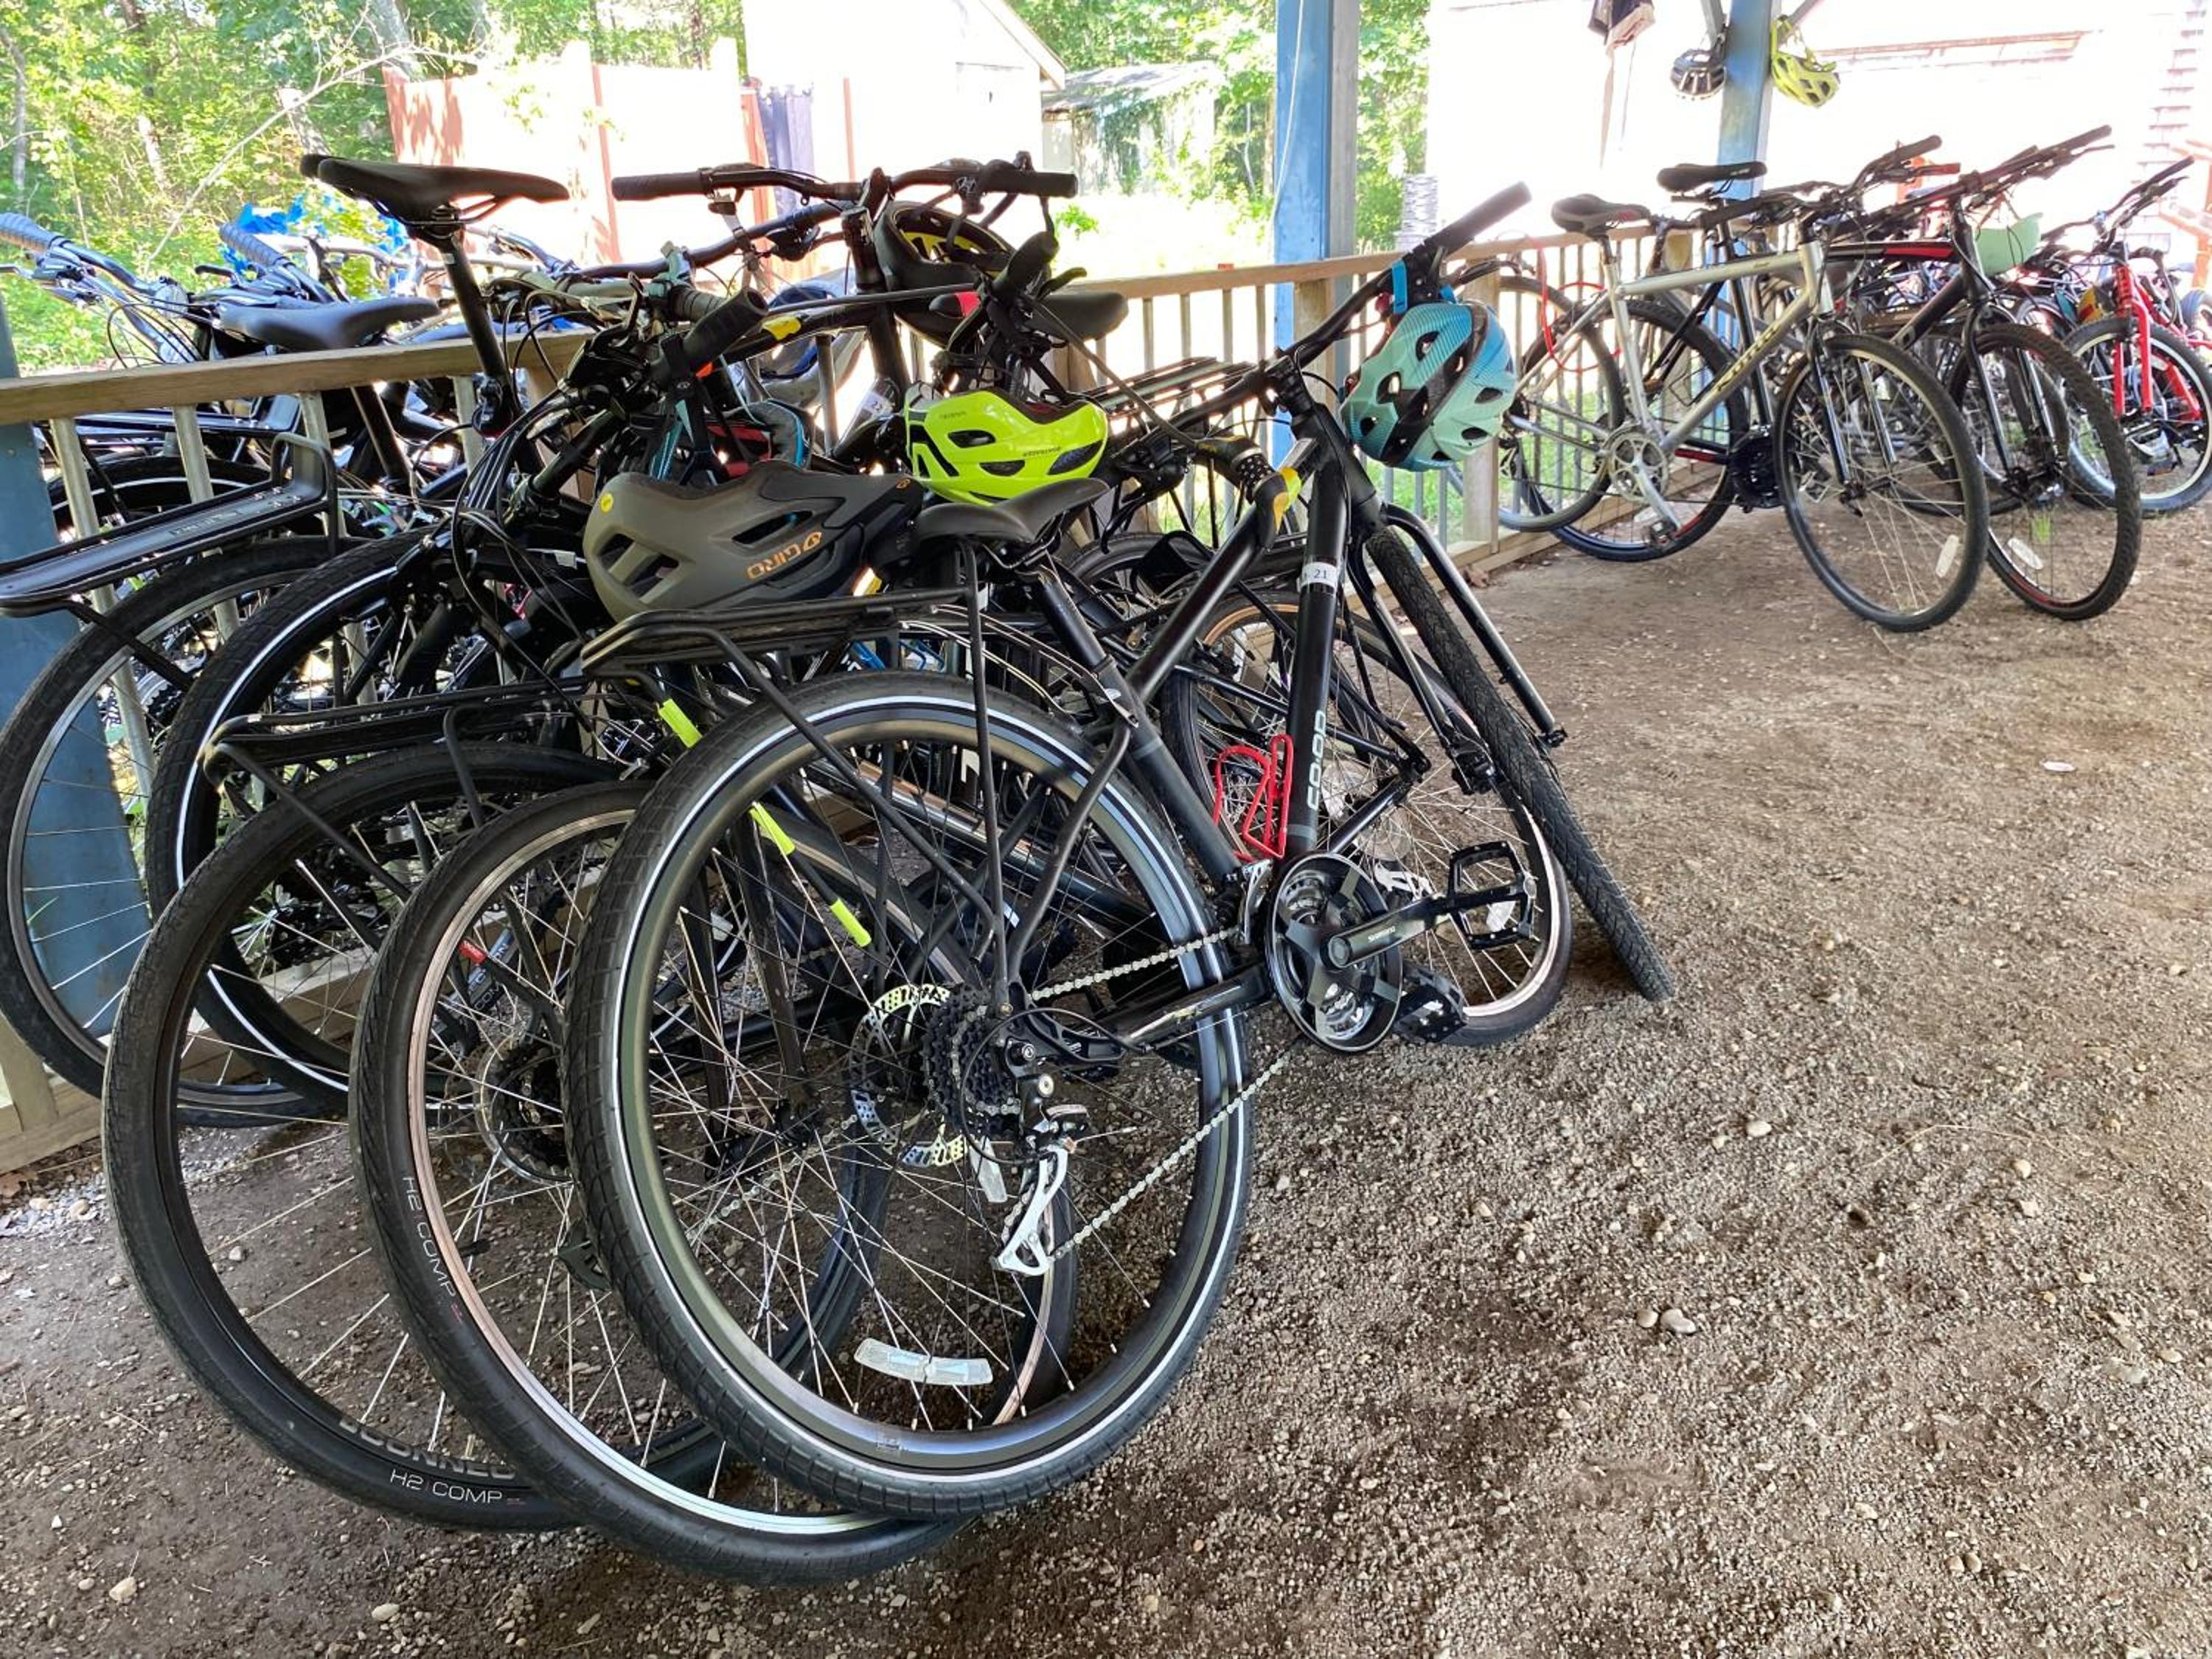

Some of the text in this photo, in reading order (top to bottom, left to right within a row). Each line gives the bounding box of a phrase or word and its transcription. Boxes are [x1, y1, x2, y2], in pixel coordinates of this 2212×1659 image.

[746, 543, 802, 579] GIRO
[1313, 568, 1327, 579] 21
[403, 1177, 456, 1298] H2 COMP
[390, 1468, 503, 1504] H2 COMP
